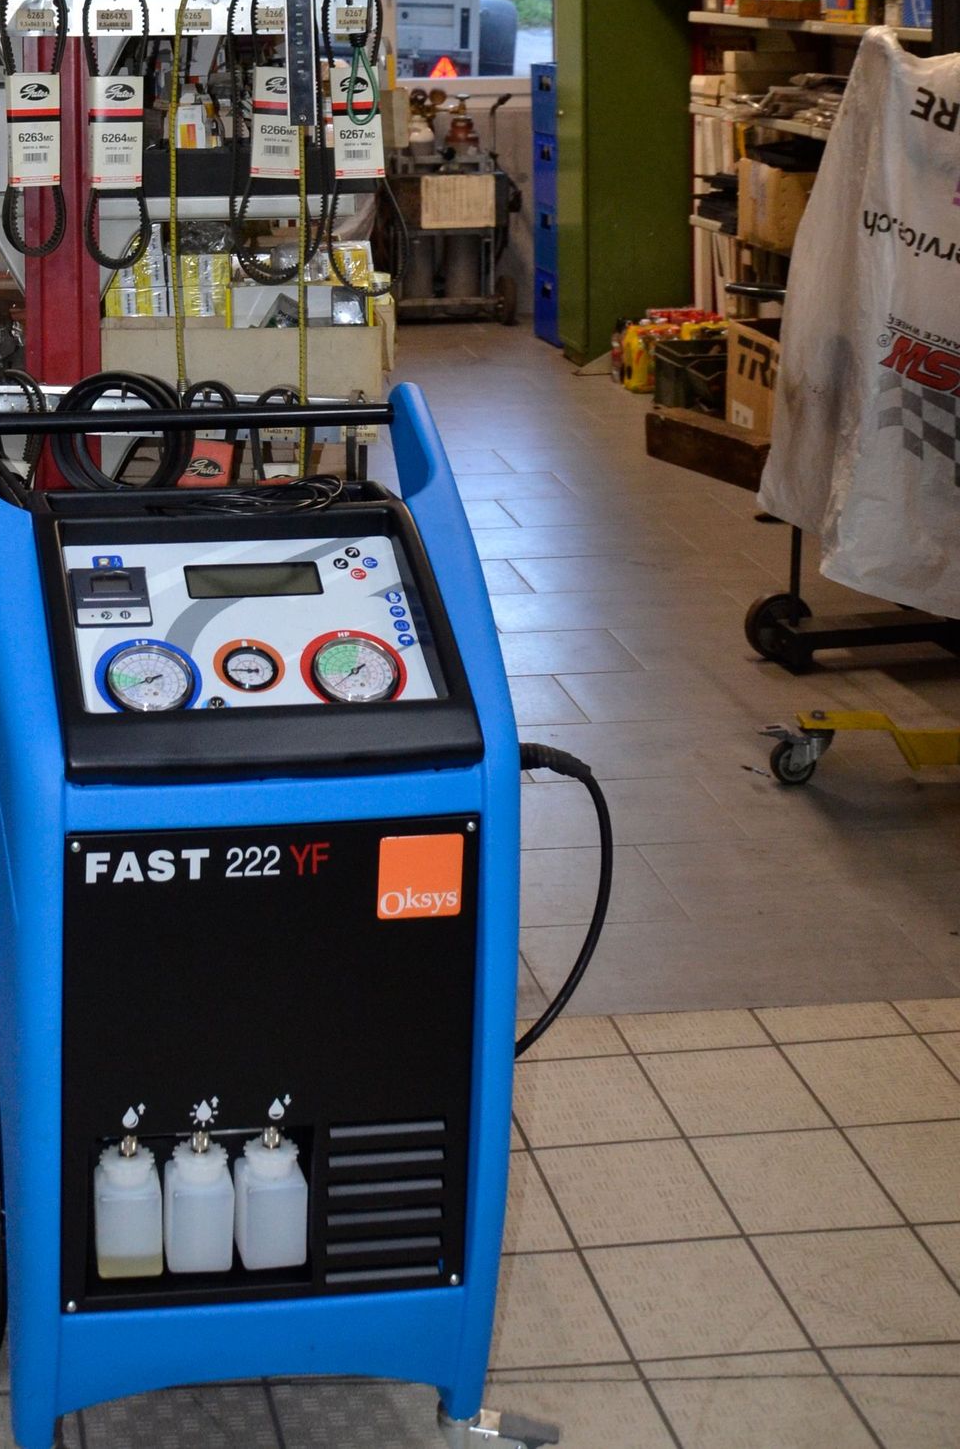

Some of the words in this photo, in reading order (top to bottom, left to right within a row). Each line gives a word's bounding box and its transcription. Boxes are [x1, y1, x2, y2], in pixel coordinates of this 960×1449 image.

[20, 83, 51, 101] Gates
[105, 84, 135, 101] Gates
[18, 133, 55, 142] 6263MC
[101, 134, 138, 143] 6264MC
[260, 125, 298, 136] 6266MC
[340, 130, 376, 140] 6267MC
[186, 459, 225, 479] Gates
[85, 848, 210, 884] FAST
[225, 845, 281, 878] 222
[289, 842, 330, 876] YF
[379, 887, 459, 916] Oksys
